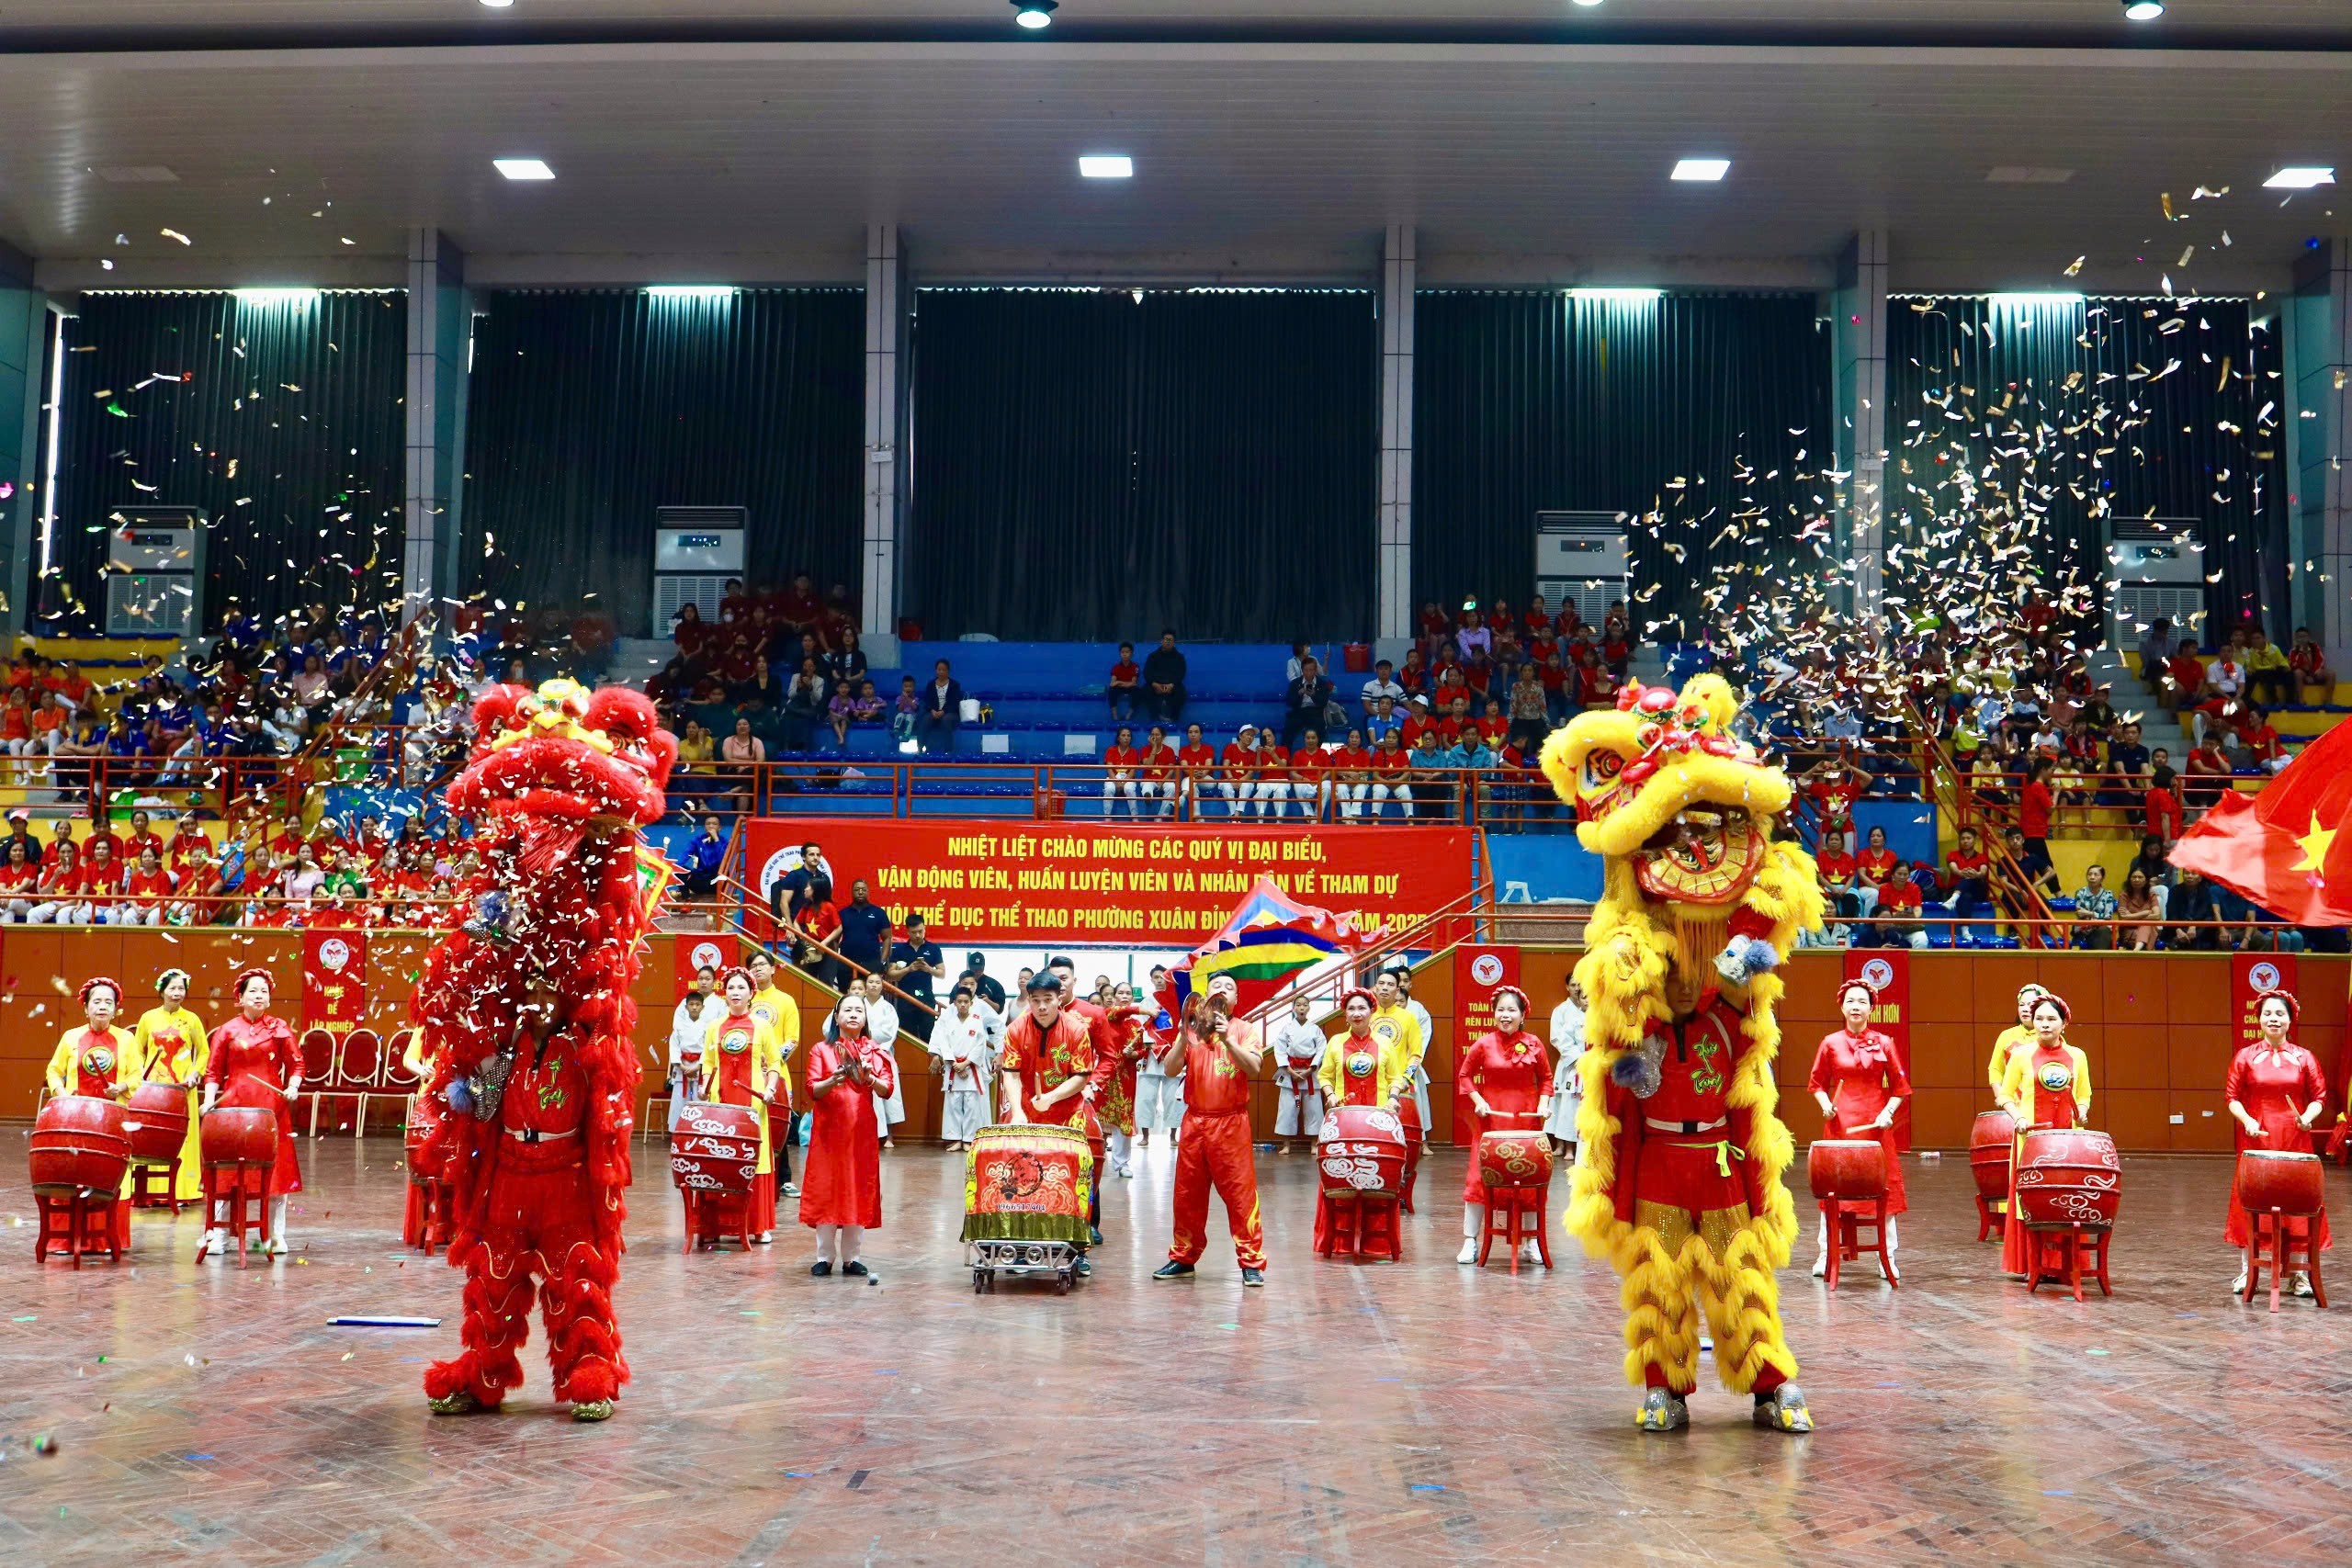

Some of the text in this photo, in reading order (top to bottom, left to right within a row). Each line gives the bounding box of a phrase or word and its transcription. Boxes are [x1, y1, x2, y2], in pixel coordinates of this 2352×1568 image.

[948, 833, 1327, 864] NHIỆT LIỆT CHÀO MỪNG CÁC QUÝ VỊ ĐẠI BIỂU,
[878, 865, 912, 892] VẬN
[917, 865, 964, 893] ĐỘNG
[969, 866, 1012, 892] VIÊN,
[1018, 864, 1065, 890] HUẤN
[1070, 868, 1124, 895] LUYỆN
[1129, 868, 1168, 892] VIÊN
[1173, 869, 1195, 892] VÀ
[1201, 870, 1249, 893] NHÂN
[1295, 868, 1315, 894] VỀ
[1320, 874, 1369, 894] THAM
[1374, 874, 1399, 898] DỰ
[950, 907, 984, 931] DỤC
[989, 900, 1020, 927] THỂ
[1025, 908, 1069, 928] THAO
[1073, 905, 1144, 930] PHƯỜNG
[1149, 907, 1196, 930] XUÂN
